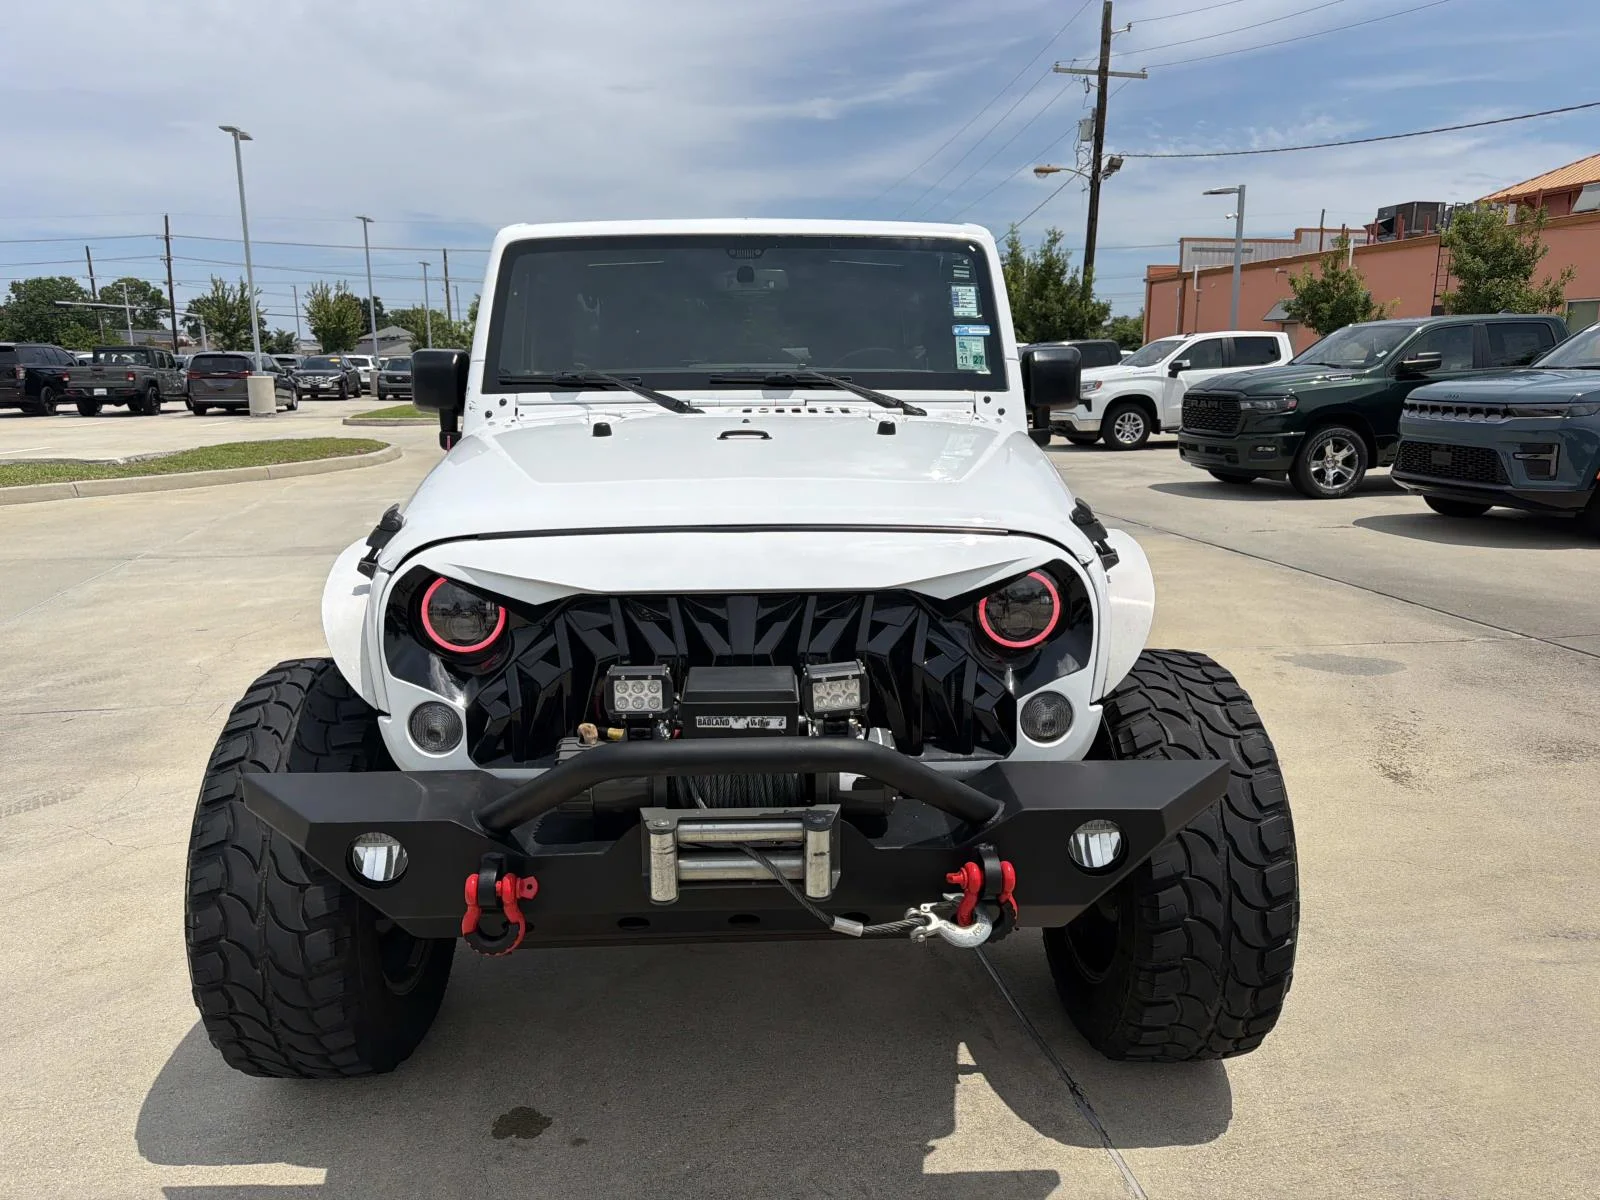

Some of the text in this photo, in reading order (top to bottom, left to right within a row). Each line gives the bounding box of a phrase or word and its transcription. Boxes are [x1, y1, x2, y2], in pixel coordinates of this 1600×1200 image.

[960, 355, 984, 365] 11 27
[697, 717, 730, 727] BADLAND
